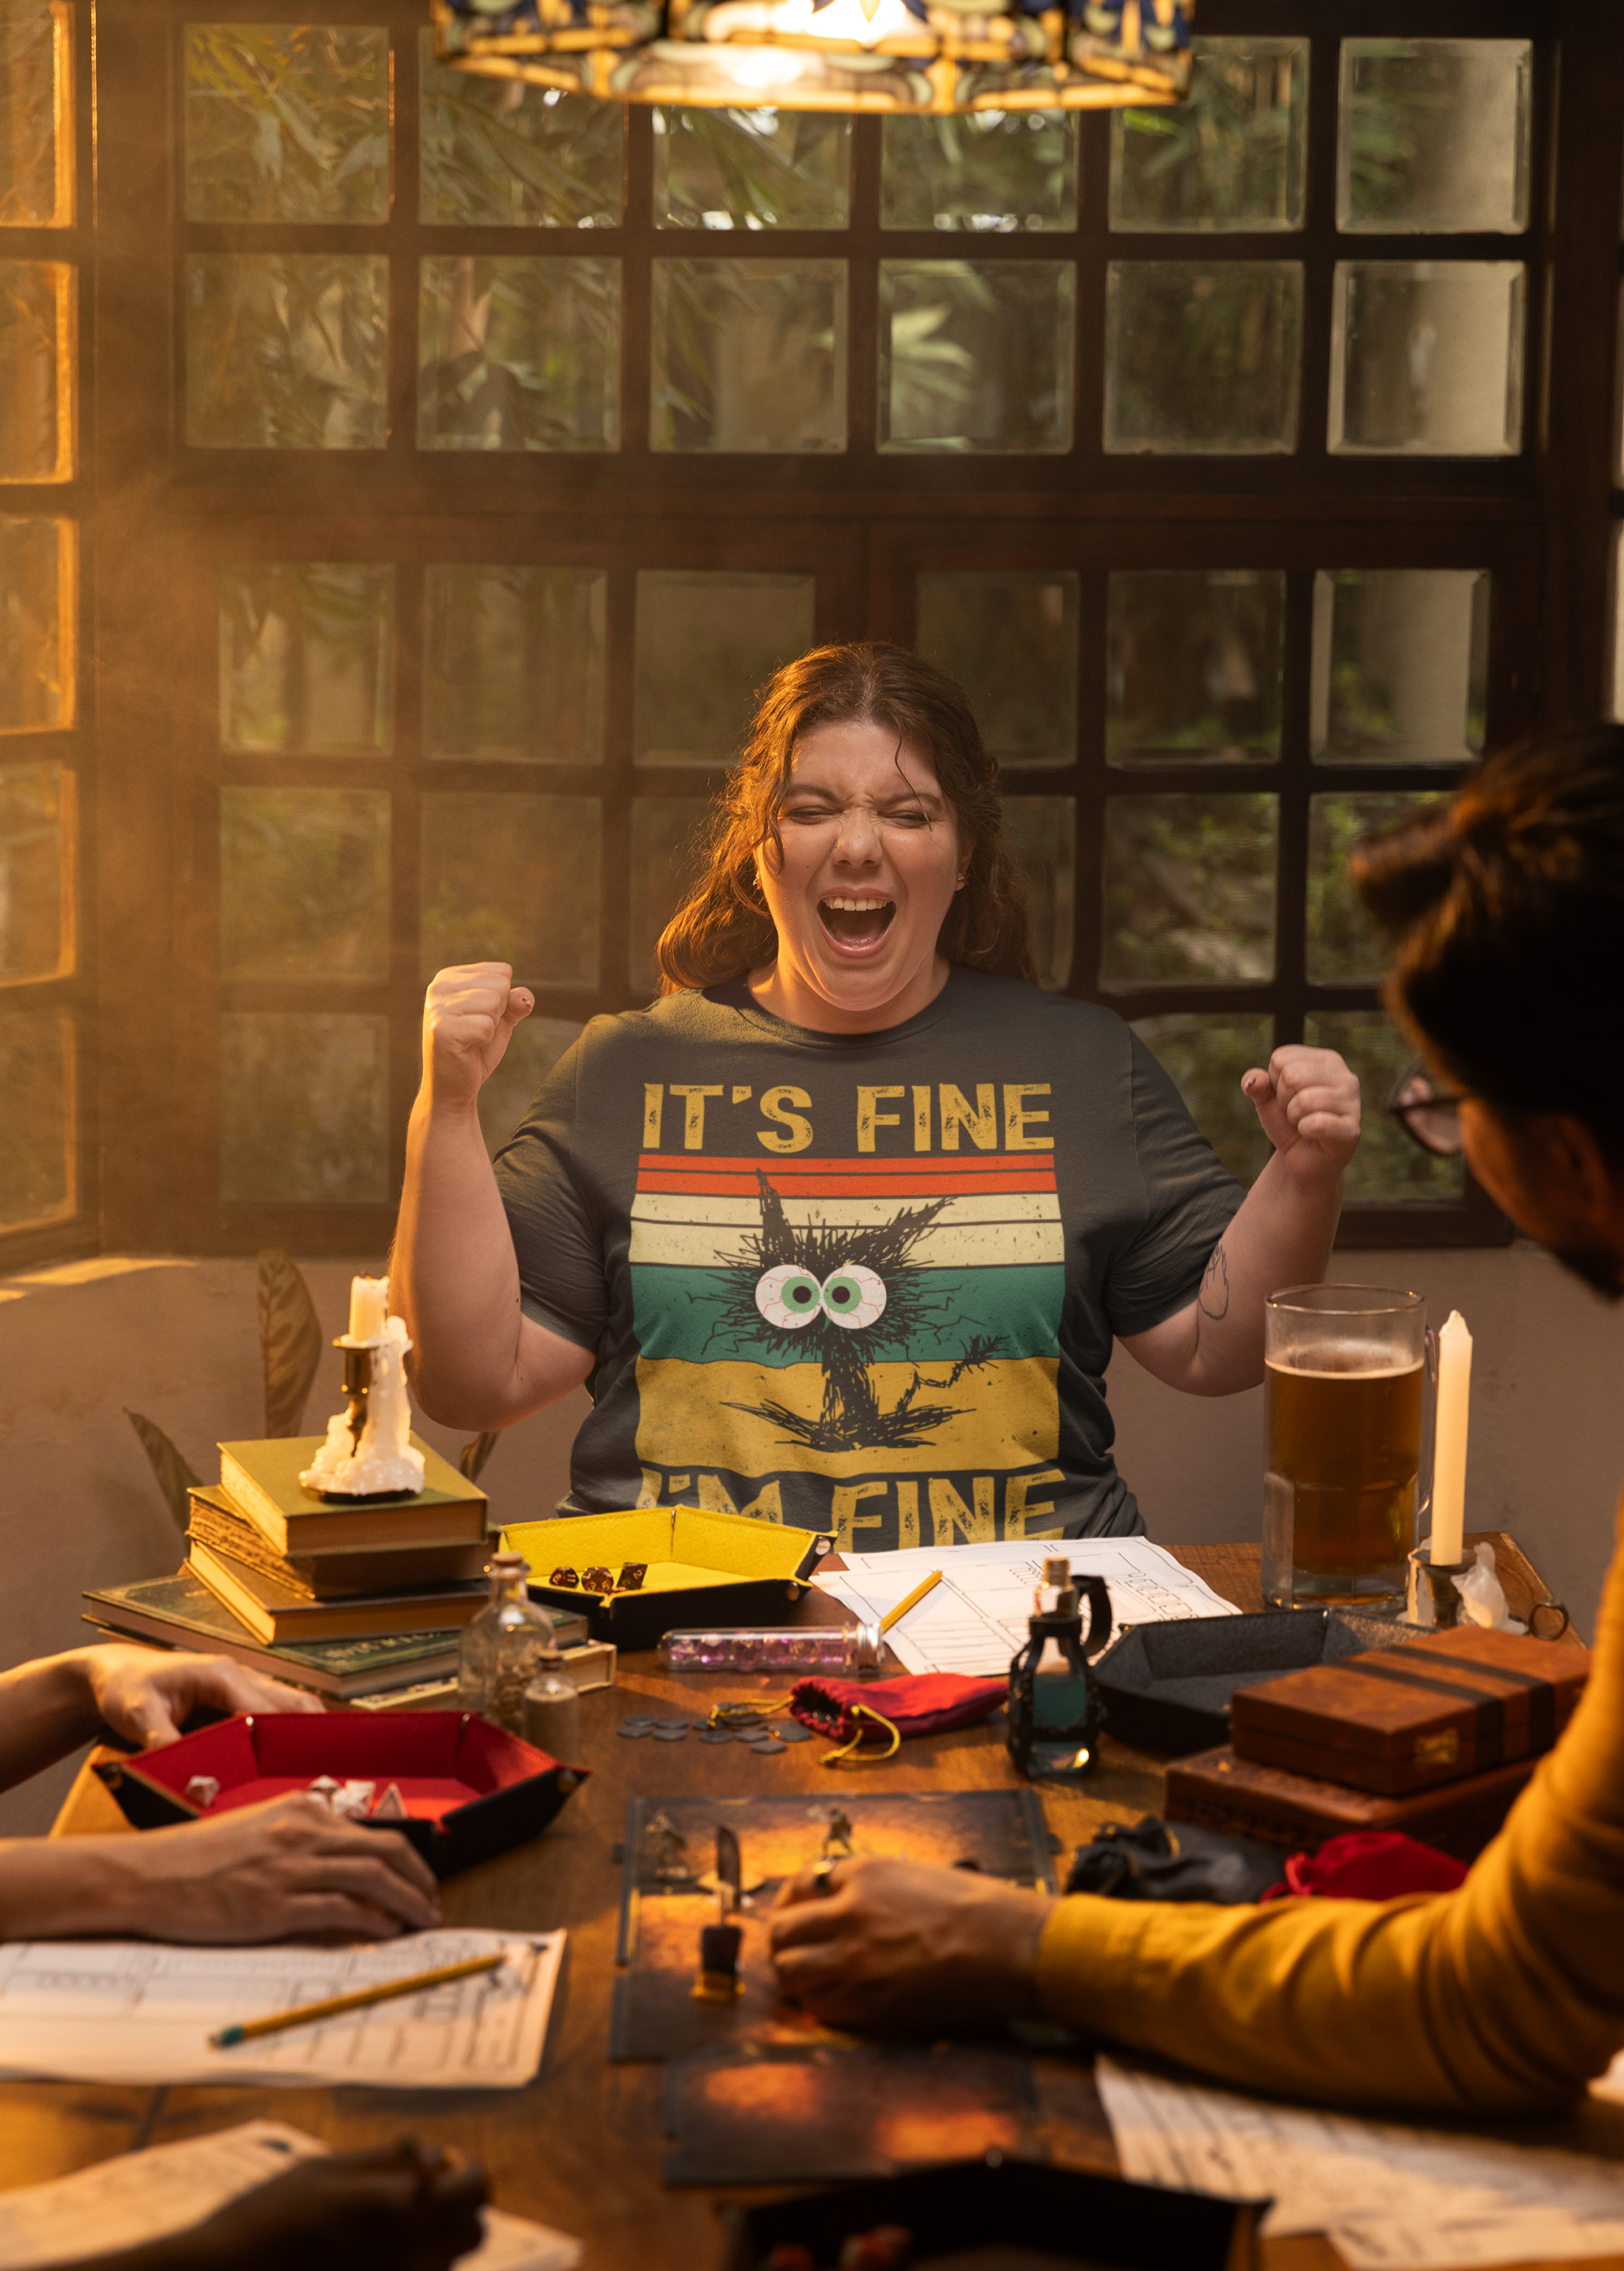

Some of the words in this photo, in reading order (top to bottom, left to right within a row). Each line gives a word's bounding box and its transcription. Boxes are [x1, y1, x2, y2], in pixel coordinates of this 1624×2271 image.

[643, 1084, 813, 1153] IT'S
[857, 1083, 1054, 1152] FINE
[831, 1469, 1065, 1554] FINE
